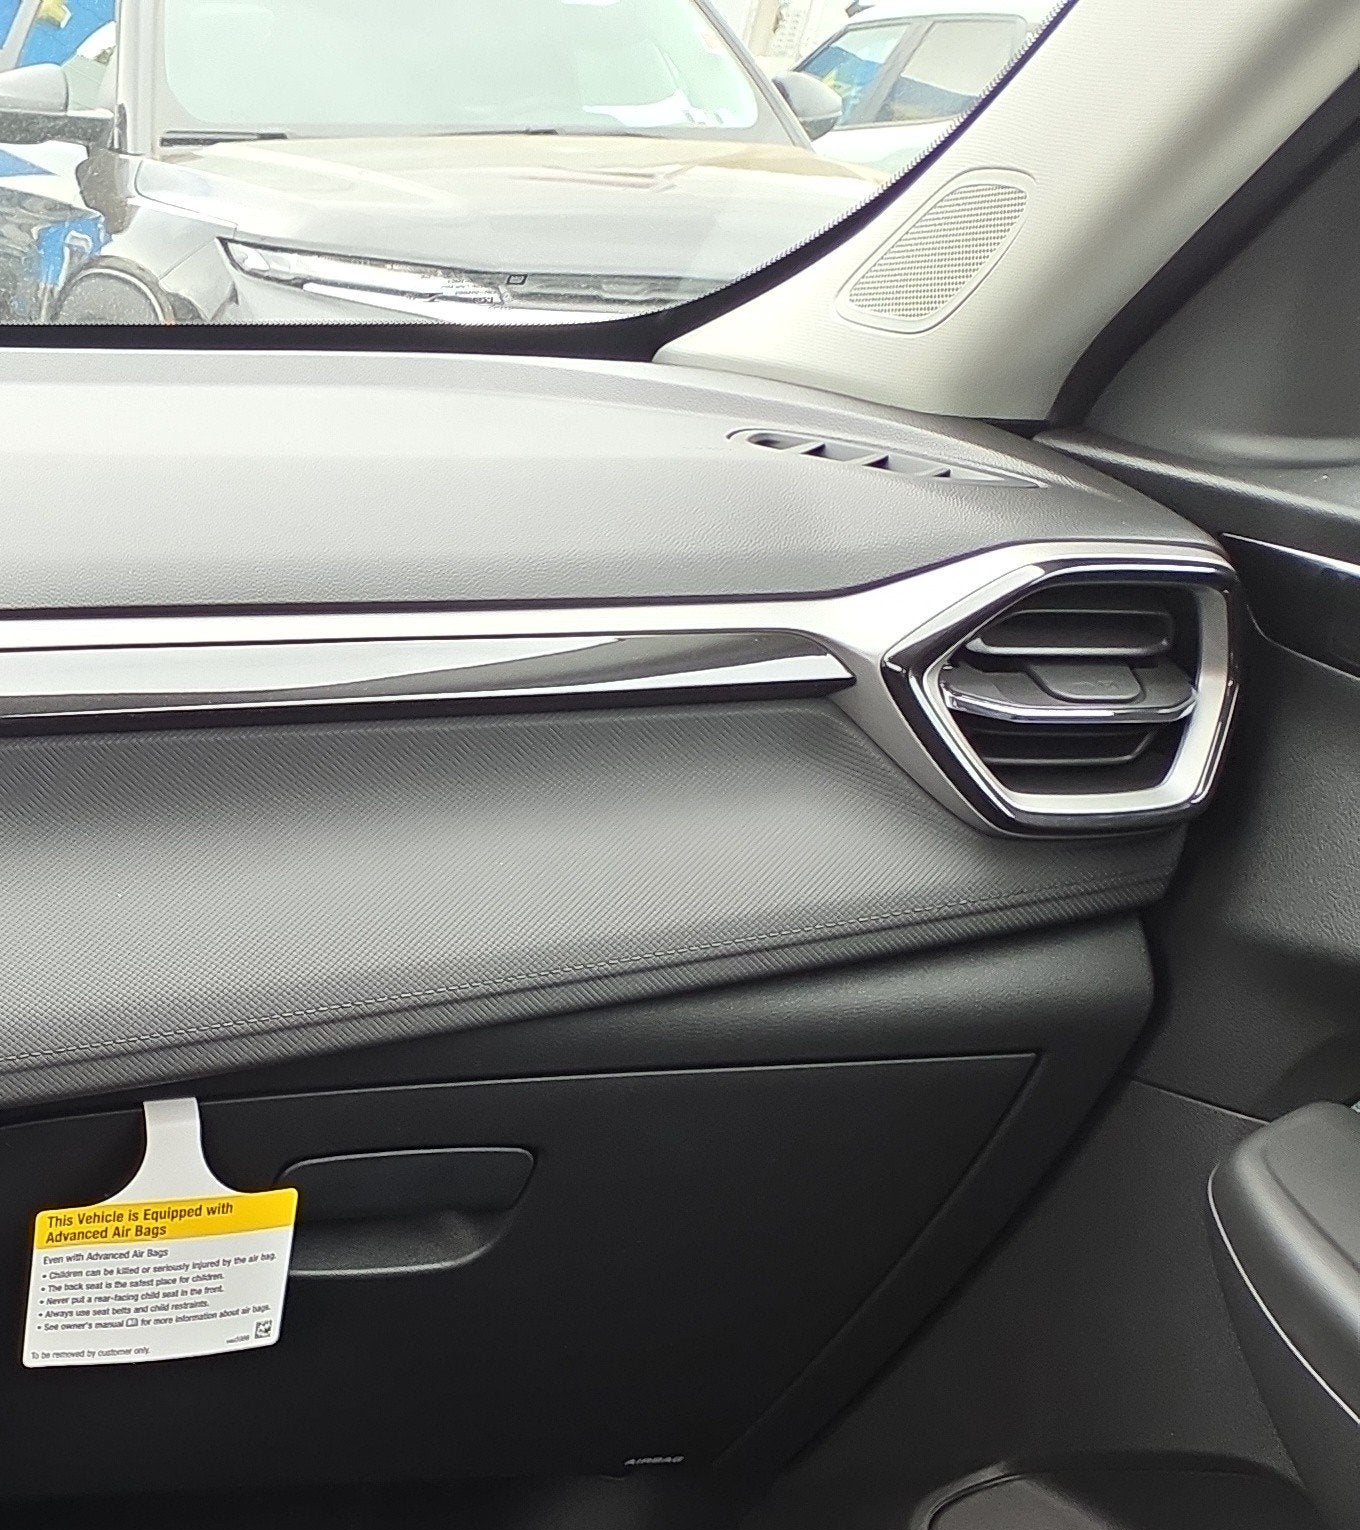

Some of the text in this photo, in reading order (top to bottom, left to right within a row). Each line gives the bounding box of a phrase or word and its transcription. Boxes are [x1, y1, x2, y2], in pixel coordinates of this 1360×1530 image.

[47, 1203, 233, 1228] This Vehicle is Equipped with
[46, 1224, 167, 1244] Advanced Air Bags
[43, 1248, 168, 1265] Even with Advanced Air Bags
[49, 1270, 83, 1279] Children
[85, 1269, 101, 1277] can
[103, 1268, 114, 1276] be
[116, 1266, 140, 1275] killed
[153, 1263, 189, 1273] seriously
[192, 1259, 220, 1270] injured
[222, 1258, 231, 1267] by
[234, 1256, 246, 1264] the
[48, 1284, 62, 1292] The
[64, 1282, 83, 1291] back
[85, 1281, 103, 1290] seat
[114, 1280, 127, 1288] the
[129, 1278, 154, 1287] safest
[155, 1277, 176, 1287] place
[192, 1273, 224, 1283] children.
[46, 1296, 69, 1305] Never
[71, 1295, 85, 1305] put
[94, 1293, 139, 1303] rear-facing
[141, 1291, 160, 1300] child
[162, 1289, 179, 1298] seat
[190, 1287, 202, 1296] the
[204, 1284, 224, 1294] front.
[44, 1309, 73, 1319] Always
[75, 1309, 90, 1317] use
[92, 1307, 110, 1316] seat
[112, 1306, 131, 1315] belts
[133, 1304, 148, 1313] and
[150, 1303, 169, 1312] child
[44, 1322, 59, 1331] See
[61, 1321, 92, 1330] owner's
[95, 1320, 124, 1329] manual
[153, 1316, 173, 1325] more
[175, 1311, 217, 1323] information
[219, 1309, 240, 1318] about
[52, 1350, 85, 1359] removed
[86, 1349, 96, 1358] by
[98, 1348, 132, 1357] customer
